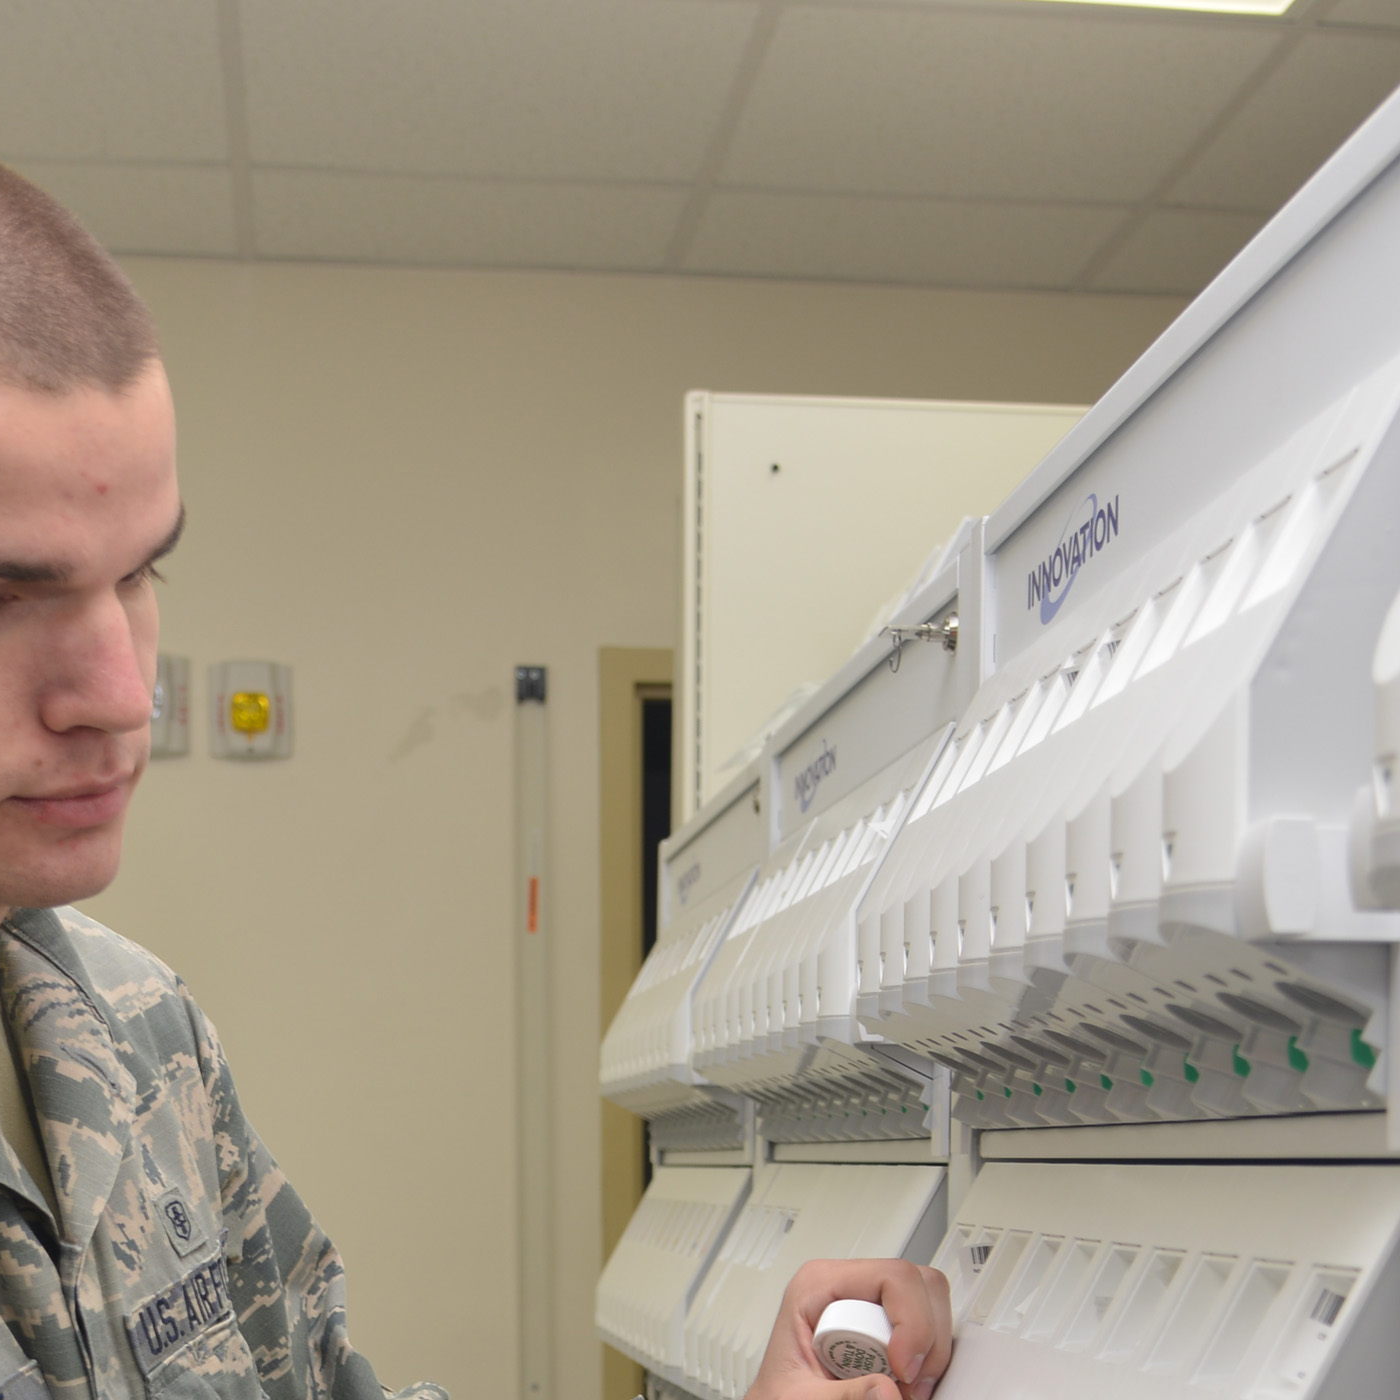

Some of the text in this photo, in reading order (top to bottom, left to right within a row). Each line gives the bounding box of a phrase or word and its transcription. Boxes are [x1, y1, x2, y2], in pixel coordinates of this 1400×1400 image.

[1027, 494, 1119, 611] INNOVATION
[138, 1297, 185, 1357] U.S.
[181, 1271, 215, 1332] AIR
[841, 1349, 855, 1369] TURN
[852, 1348, 866, 1371] DOWN
[863, 1353, 876, 1372] PUSH
